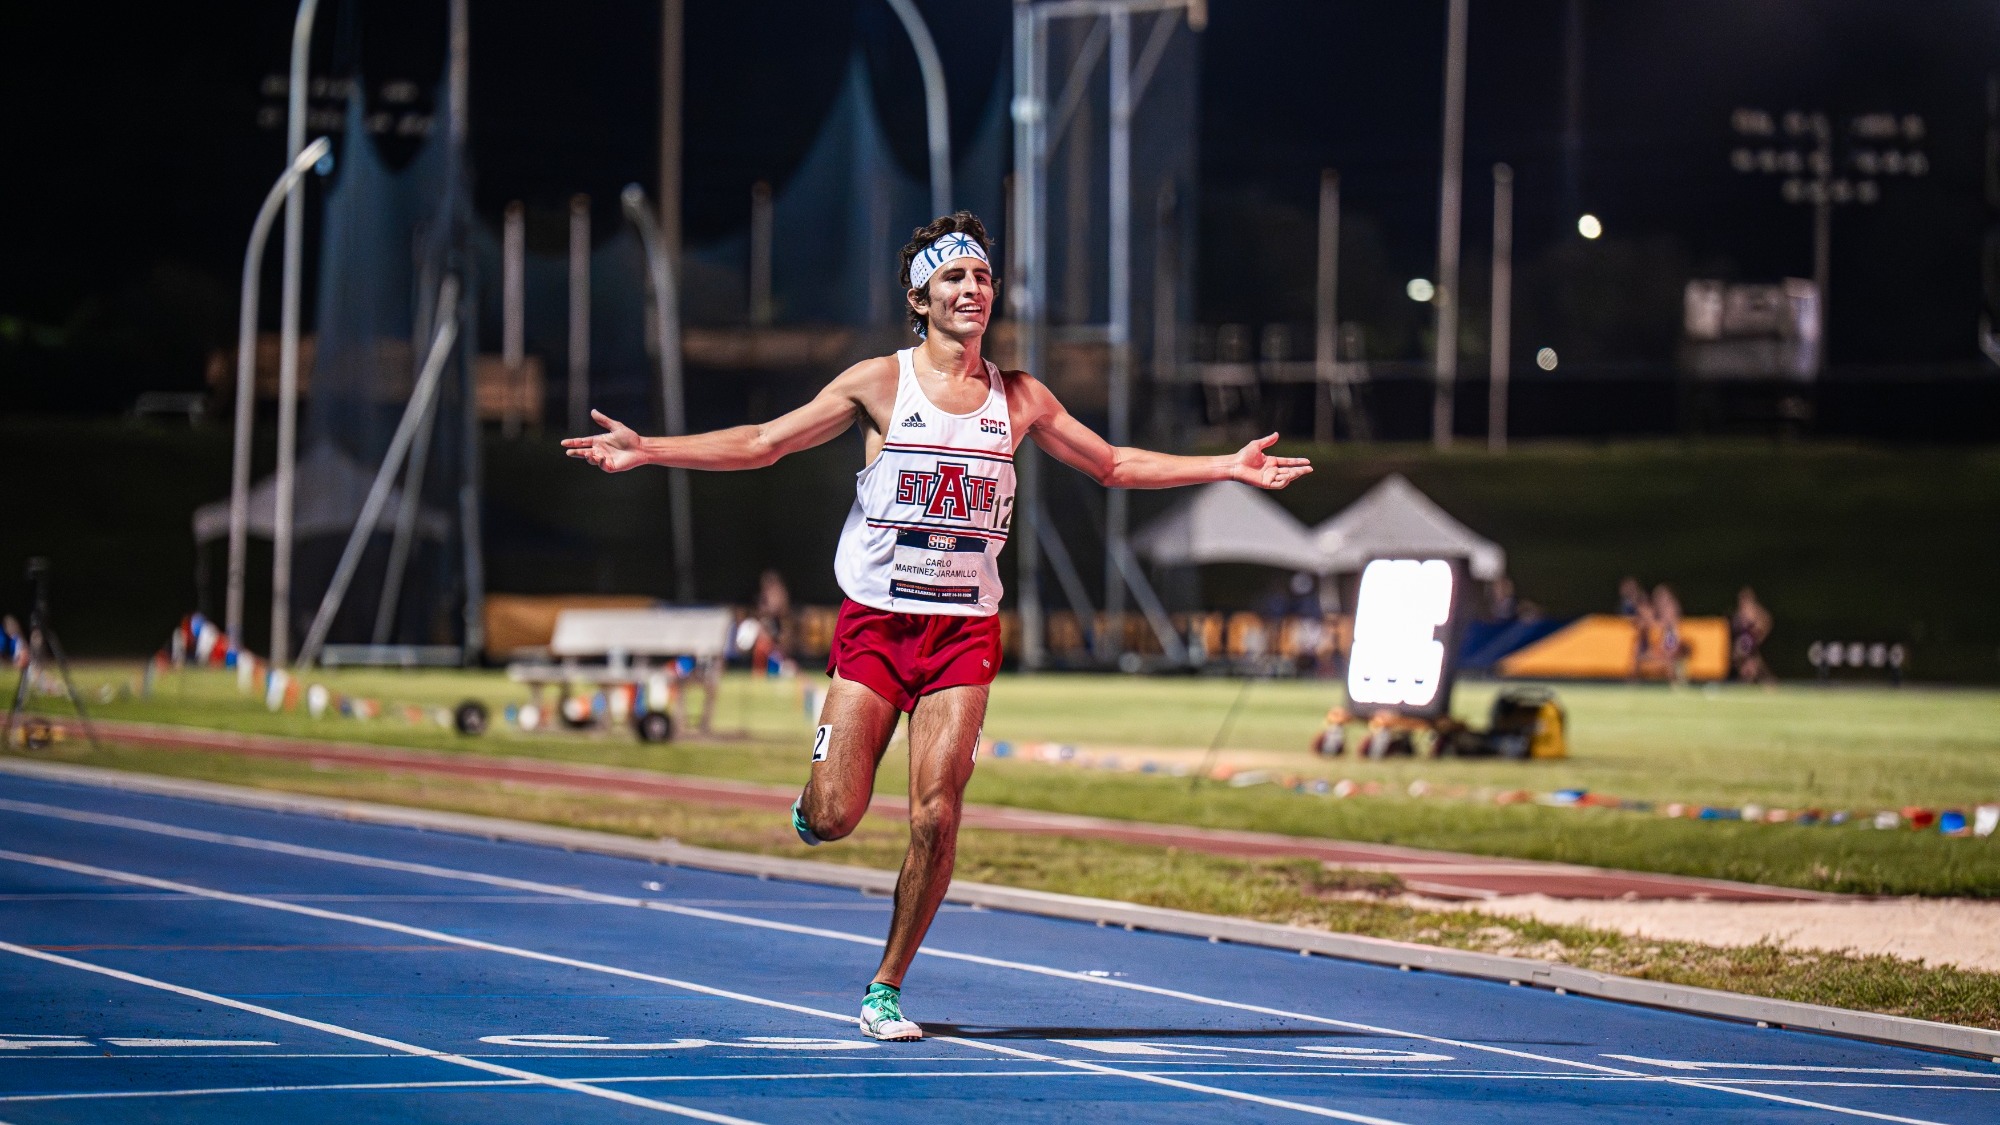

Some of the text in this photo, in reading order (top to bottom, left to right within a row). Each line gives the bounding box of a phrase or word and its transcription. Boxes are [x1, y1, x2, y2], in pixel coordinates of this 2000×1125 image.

[980, 418, 1006, 435] SBC
[896, 461, 998, 520] STATE
[928, 534, 957, 551] SBC
[894, 563, 977, 578] MARTINEZ-JARAMILLO
[925, 558, 952, 567] CARLO
[478, 1034, 881, 1050] 3
